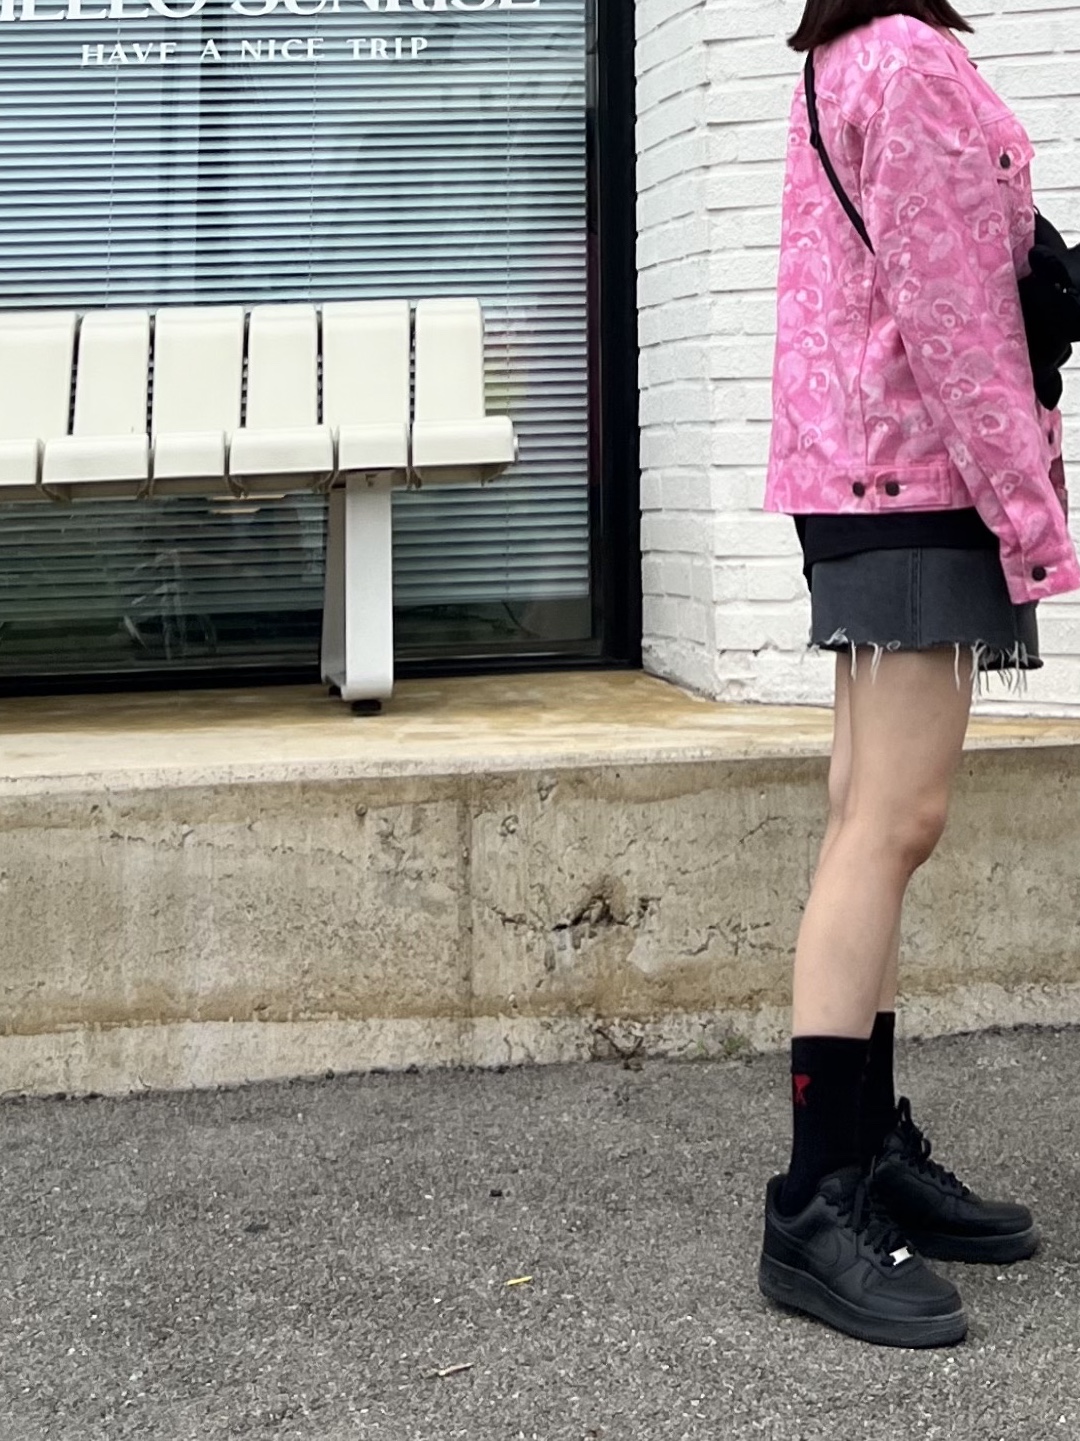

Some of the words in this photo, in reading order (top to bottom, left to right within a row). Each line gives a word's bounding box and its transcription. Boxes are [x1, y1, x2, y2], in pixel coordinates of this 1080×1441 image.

[81, 42, 177, 66] HAVE
[200, 38, 222, 61] A
[240, 38, 325, 61] NICE
[346, 36, 428, 60] TRIP
